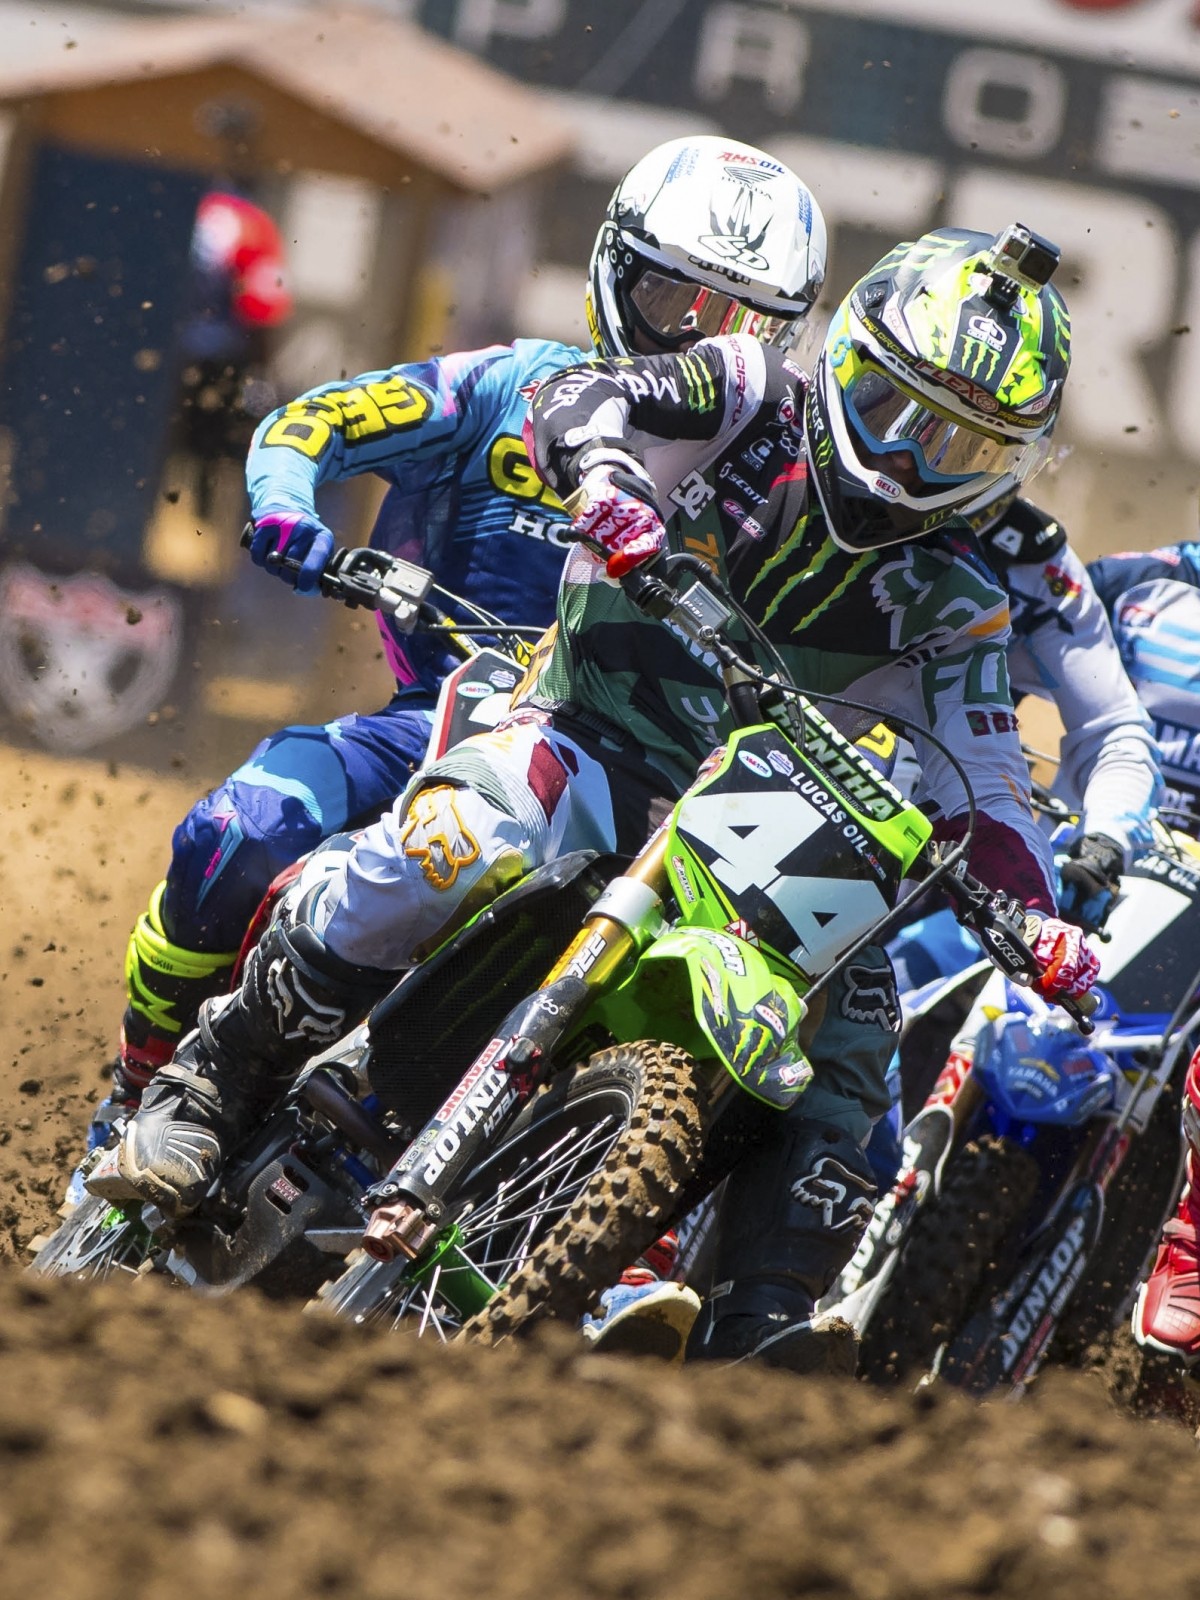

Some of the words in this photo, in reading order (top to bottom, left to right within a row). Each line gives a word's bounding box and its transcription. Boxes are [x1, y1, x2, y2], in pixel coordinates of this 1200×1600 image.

[717, 151, 786, 175] AMSOIL
[876, 331, 915, 363] CIRCUIT
[916, 361, 983, 400] FLEX
[727, 473, 769, 504] SCOTT
[875, 476, 898, 497] BELL
[790, 771, 847, 825] LUCAS
[843, 825, 870, 854] OIL
[985, 927, 1025, 967] ARC
[435, 1038, 503, 1122] BRAKING
[424, 1065, 508, 1187] UNLOP
[273, 1176, 300, 1196] LIGHT
[1002, 1215, 1086, 1370] DUNLOP
